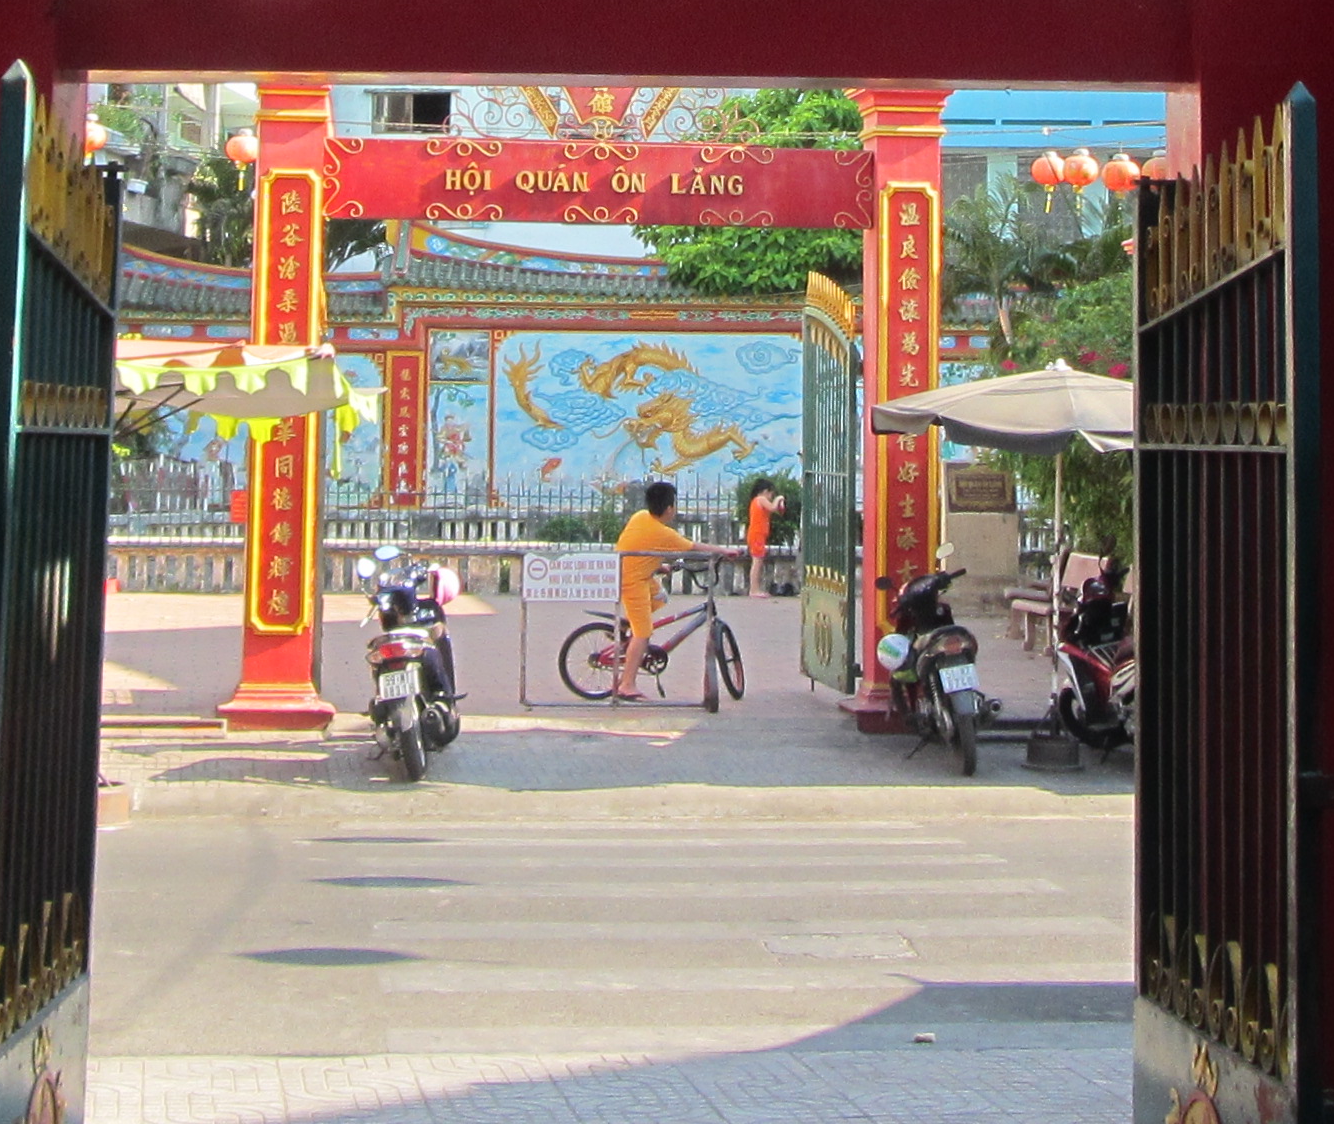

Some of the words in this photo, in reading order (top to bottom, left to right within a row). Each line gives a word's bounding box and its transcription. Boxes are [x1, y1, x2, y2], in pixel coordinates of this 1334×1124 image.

[444, 161, 493, 196] HỘI
[514, 163, 590, 194] QUÁN
[610, 166, 647, 194] ÔN
[670, 167, 745, 196] LĂNG
